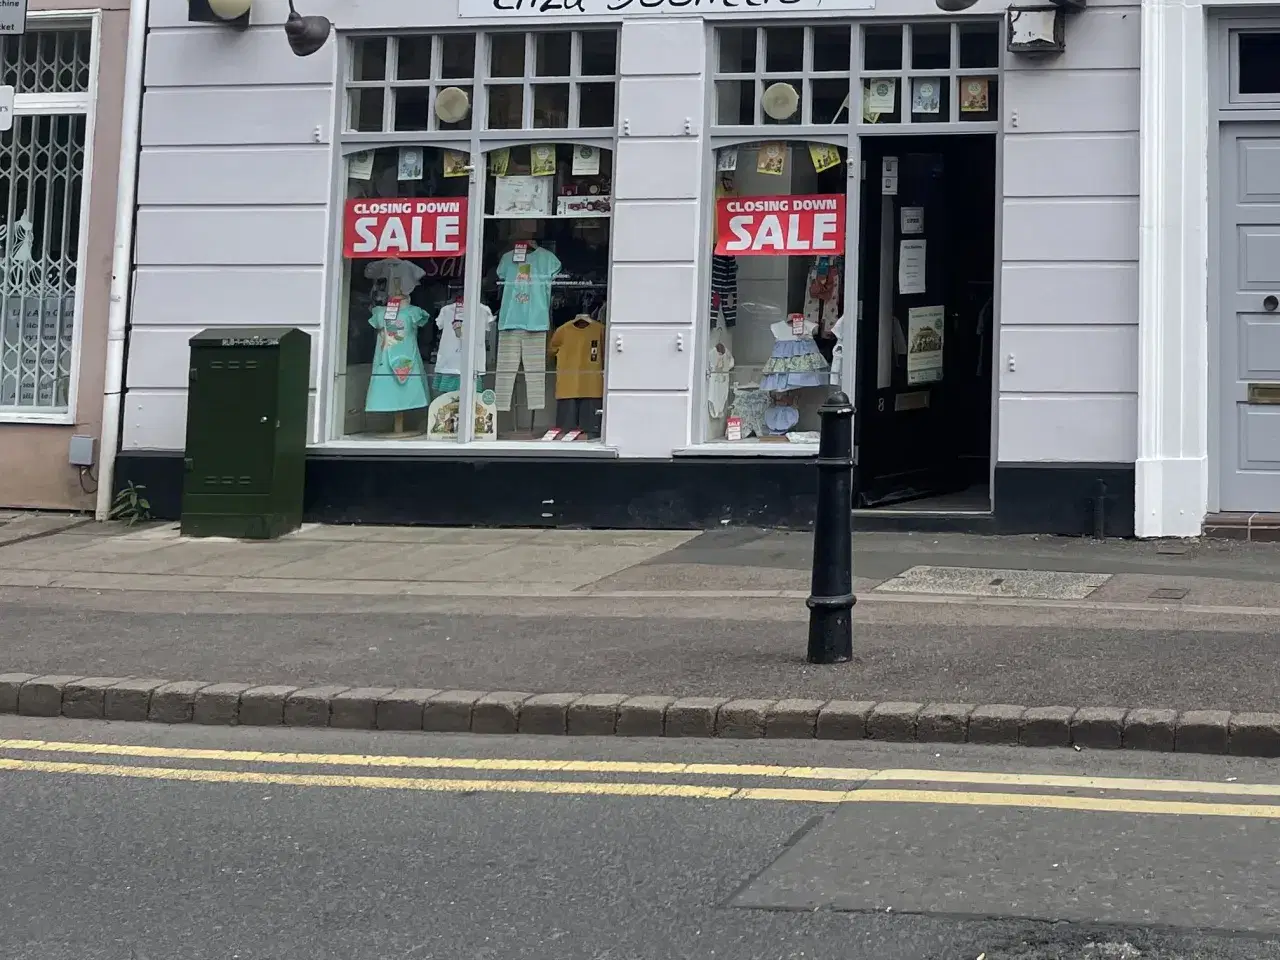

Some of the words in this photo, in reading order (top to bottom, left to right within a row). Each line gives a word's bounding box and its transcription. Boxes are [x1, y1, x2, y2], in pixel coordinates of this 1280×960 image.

[353, 203, 412, 214] CLOSING
[416, 202, 460, 213] DOWN
[726, 200, 789, 213] CLOSING
[793, 199, 837, 211] DOWN
[353, 216, 460, 253] SALE
[725, 213, 837, 251] SALE
[877, 397, 885, 412] 8
